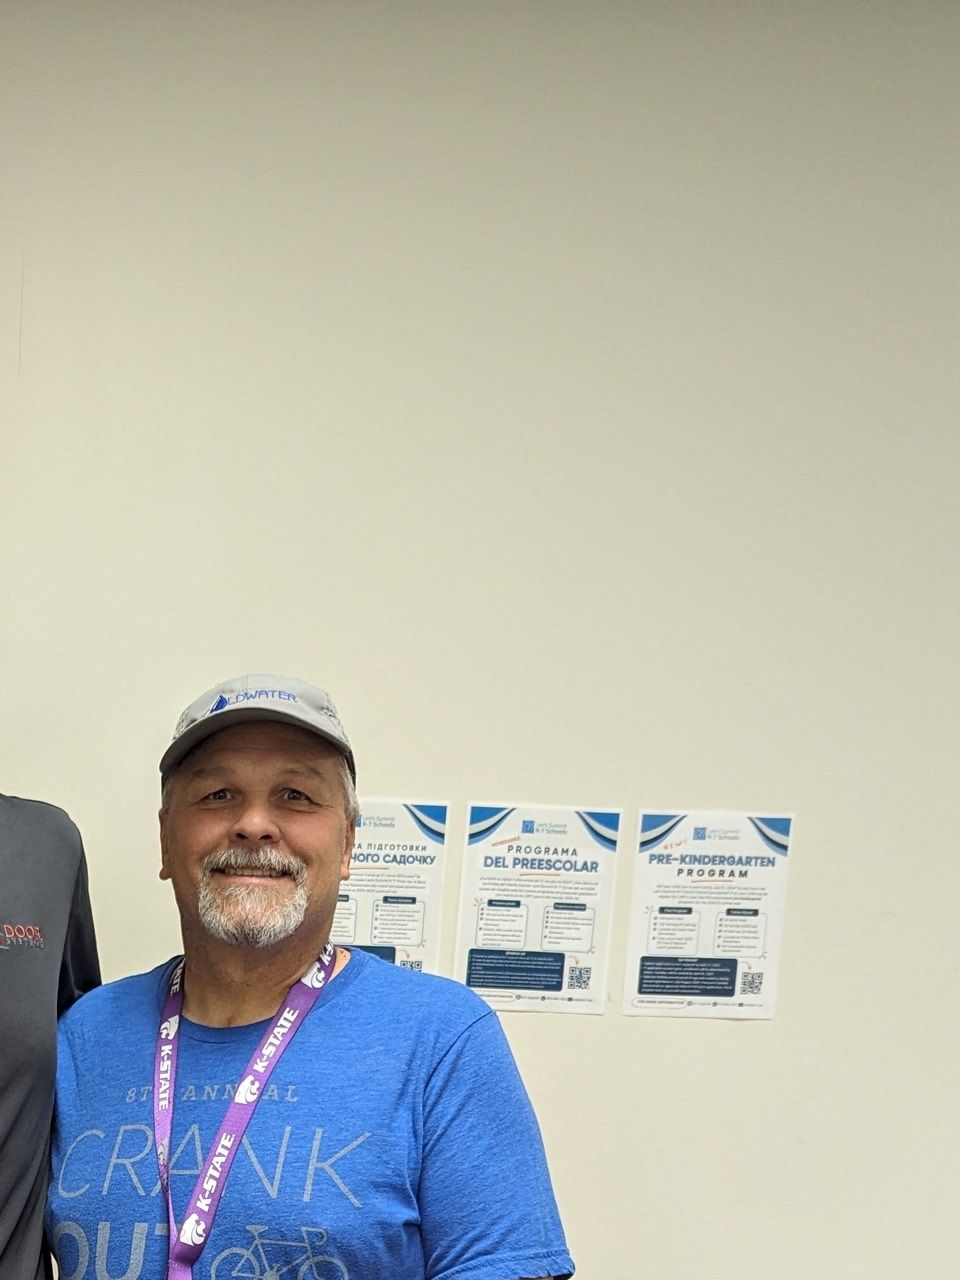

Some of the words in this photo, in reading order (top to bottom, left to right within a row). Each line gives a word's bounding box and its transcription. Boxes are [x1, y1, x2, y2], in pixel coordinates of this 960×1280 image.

[367, 844, 427, 852] ПІДГОТОВКИ
[507, 845, 578, 857] PROGRAMA
[383, 854, 436, 866] САДОЧКУ
[483, 856, 509, 868] DEL
[512, 857, 599, 873] PREESCOLAR
[648, 853, 776, 867] PRE-KINDERGARTEN
[677, 868, 748, 878] PROGRAM
[3, 924, 42, 940] DOOR
[253, 1007, 299, 1074] K-STATE
[159, 1044, 172, 1111] K-STATE
[181, 1085, 298, 1102] ANNAL
[57, 1124, 373, 1209] CRANK
[196, 1132, 235, 1212] K-STATE
